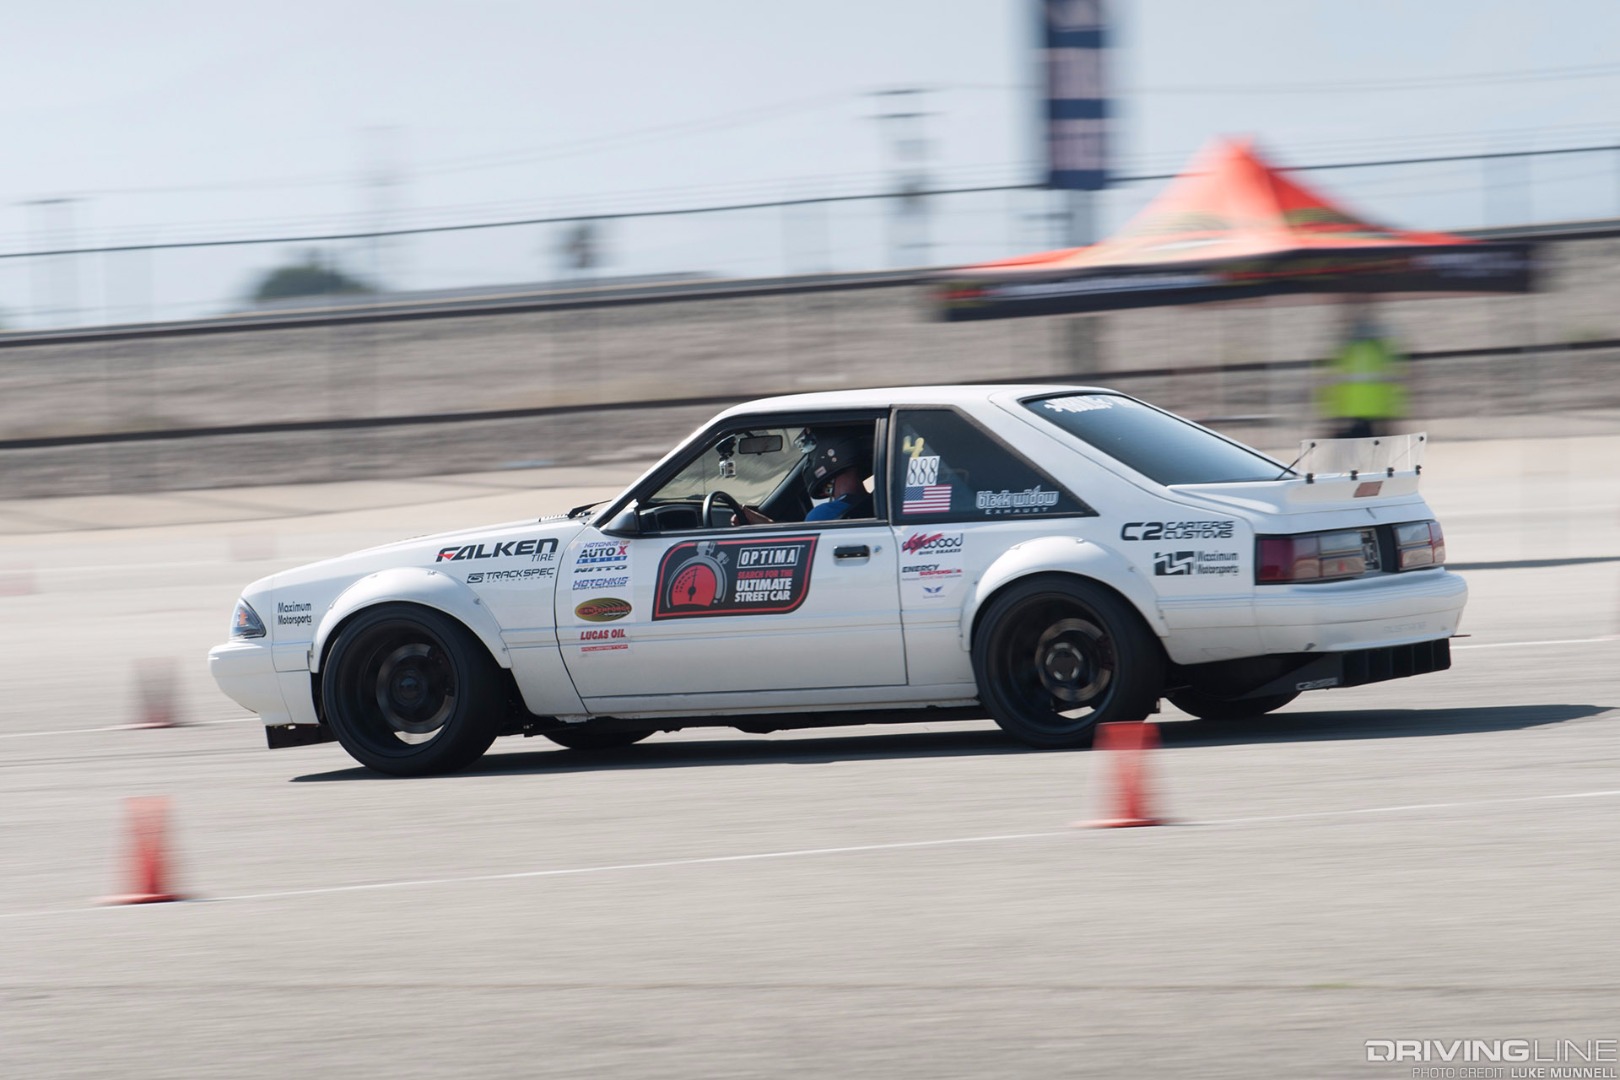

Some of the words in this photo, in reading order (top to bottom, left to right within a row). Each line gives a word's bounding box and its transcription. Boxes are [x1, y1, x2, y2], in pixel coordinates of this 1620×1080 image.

[907, 458, 938, 486] 888
[985, 507, 1048, 515] EXHAUST
[1121, 521, 1163, 541] C2
[1163, 530, 1234, 540] CUSTOMS
[435, 537, 559, 562] FALKEN
[579, 547, 616, 559] AUTO
[616, 545, 629, 556] X
[531, 552, 555, 562] TIRE
[740, 549, 796, 566] OPTIMA
[486, 567, 555, 580] TRACKSPEC
[573, 564, 628, 574] NITTO
[737, 571, 764, 579] SEARCH
[765, 570, 779, 578] FOR
[780, 569, 794, 577] THE
[573, 576, 629, 588] HOTCHKIS
[736, 578, 792, 592] ULTIMATE
[735, 592, 770, 603] STREET
[770, 590, 791, 601] CAR
[277, 601, 312, 613] Maximum
[277, 614, 312, 627] Motorsports
[580, 629, 610, 641] LUCAS
[611, 628, 627, 639] OIL
